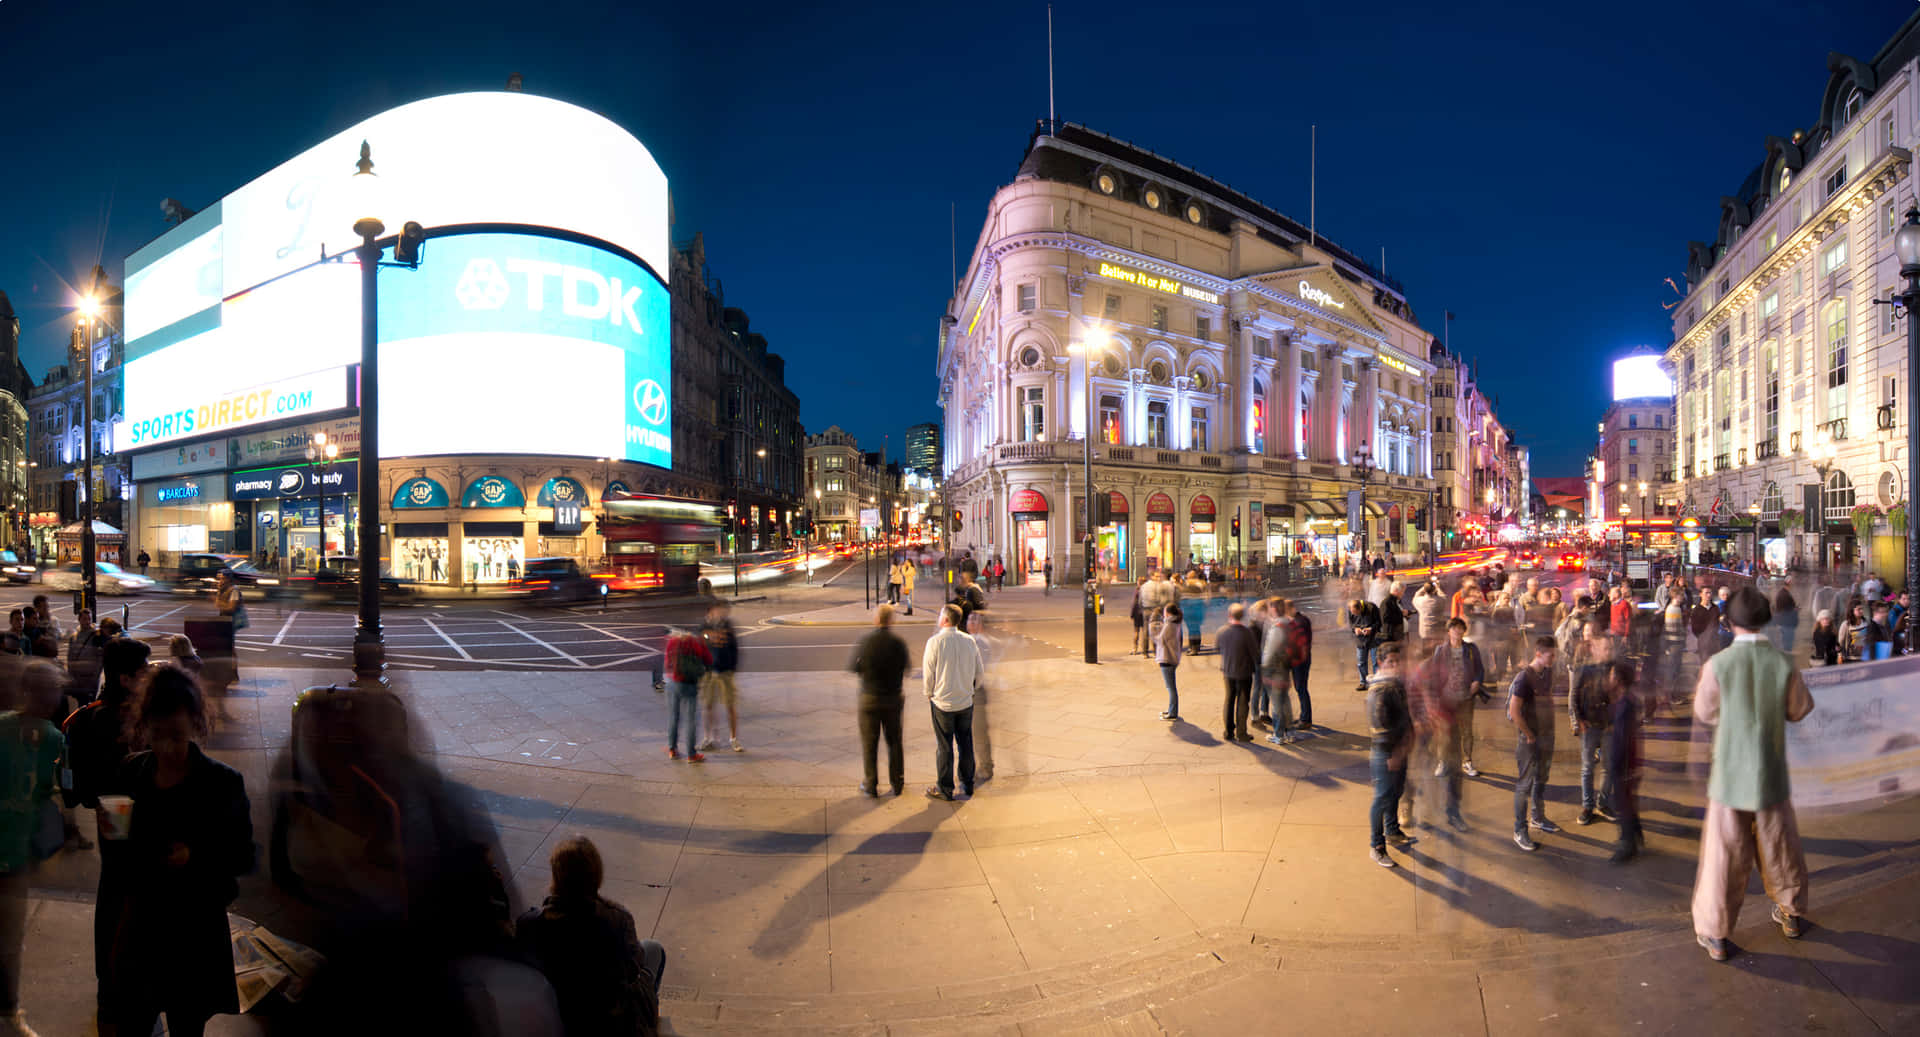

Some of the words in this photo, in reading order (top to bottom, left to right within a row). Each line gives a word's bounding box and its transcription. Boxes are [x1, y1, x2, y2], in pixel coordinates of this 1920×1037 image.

[1099, 262, 1136, 283] Believe
[1136, 271, 1147, 286] It
[1147, 277, 1159, 289] or
[1158, 278, 1181, 294] Not!
[1182, 285, 1218, 304] MUSEUM
[506, 257, 644, 335] TDK
[166, 486, 199, 500] BARCLAYS
[235, 479, 273, 493] pharmacy
[558, 507, 578, 525] GAP
